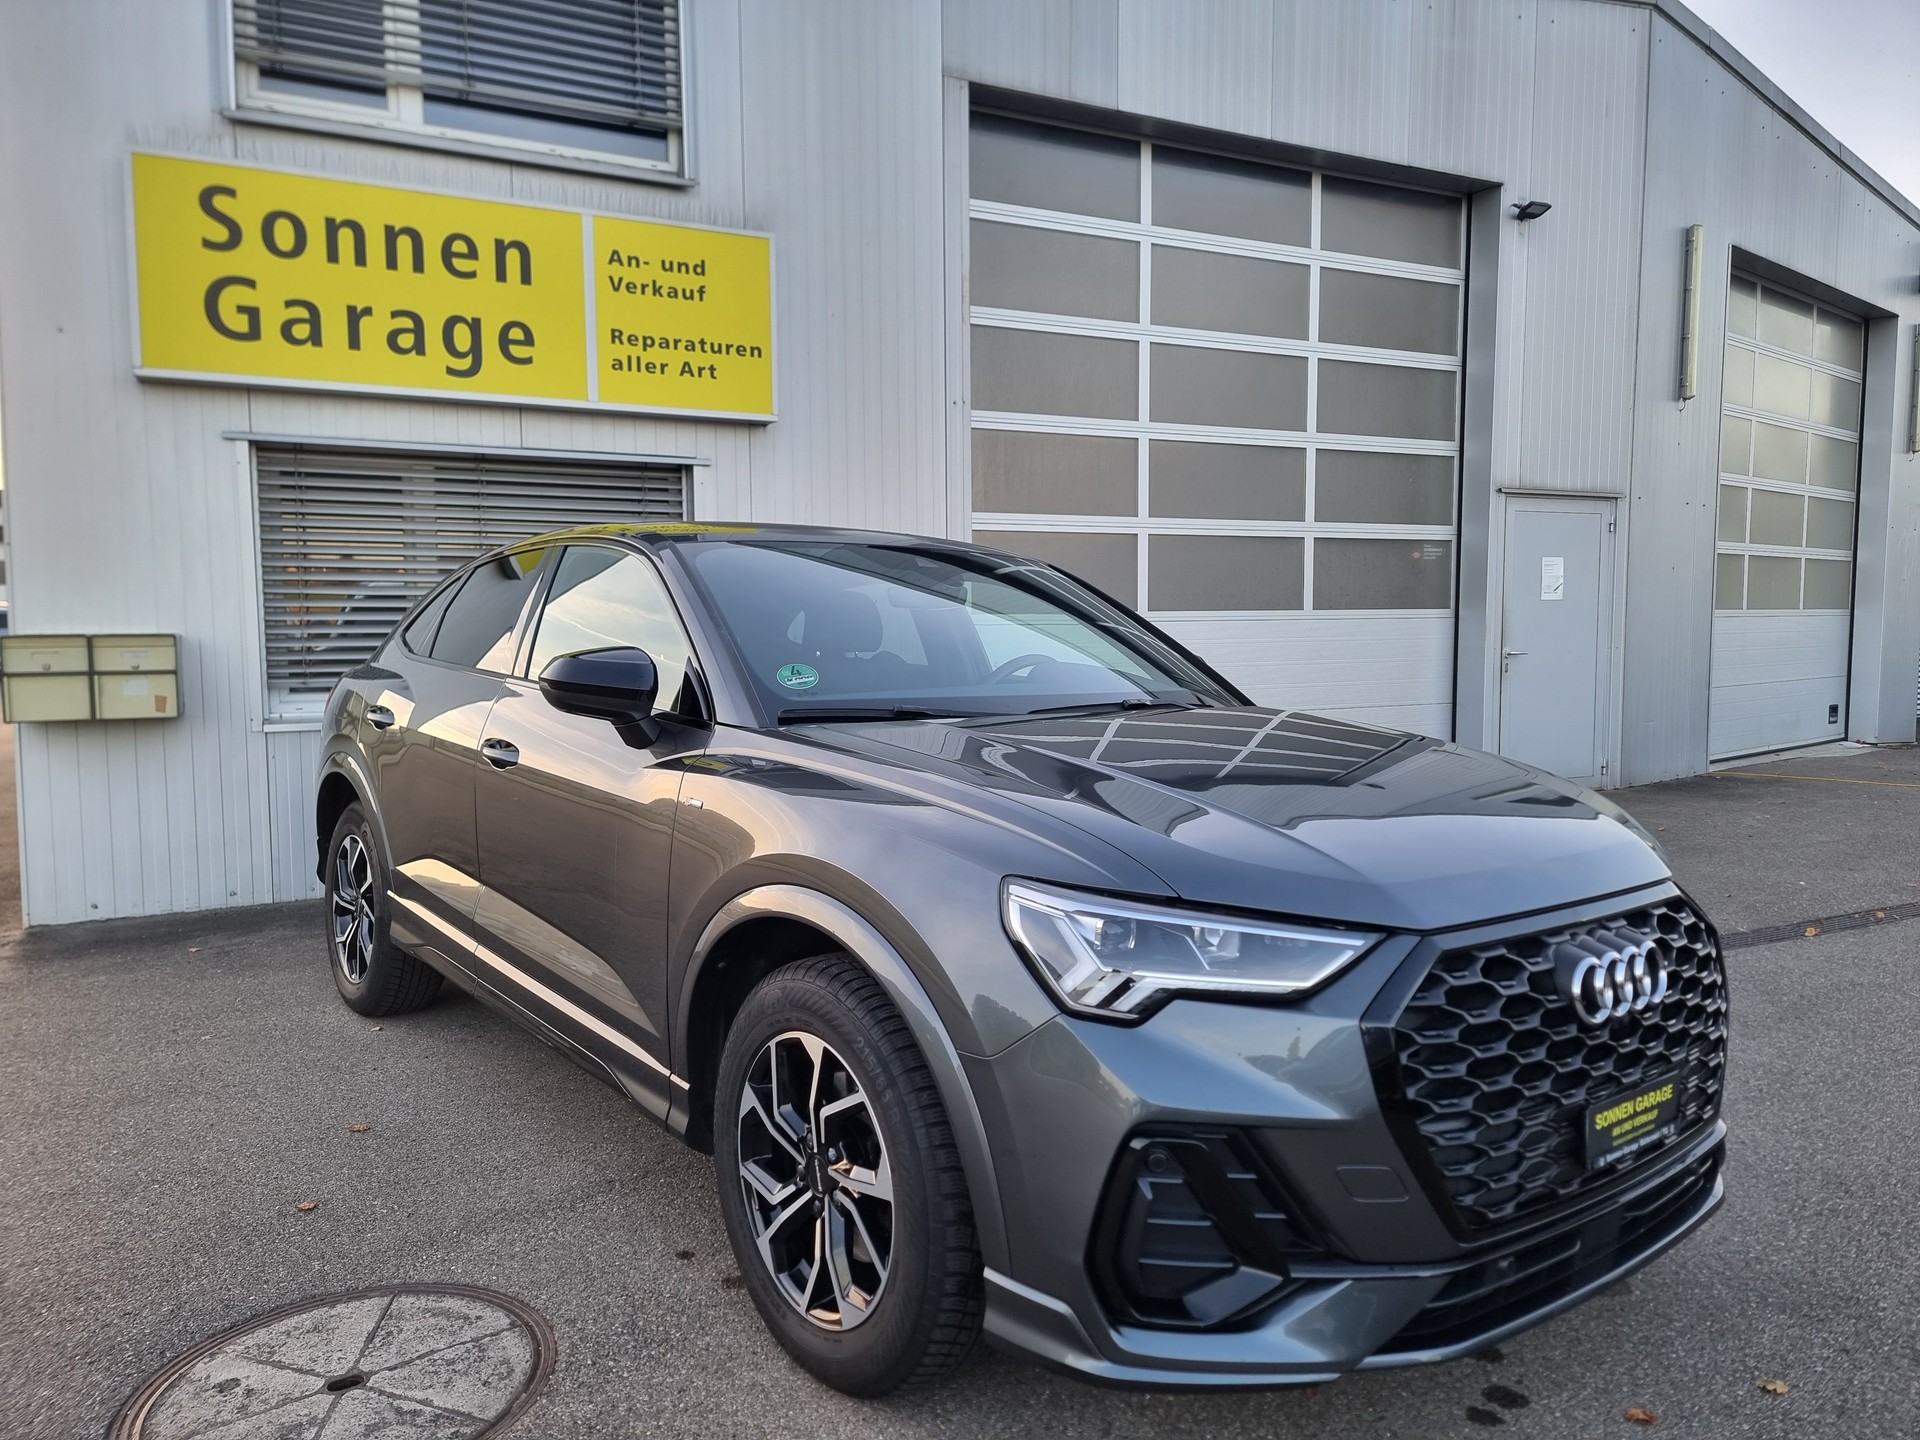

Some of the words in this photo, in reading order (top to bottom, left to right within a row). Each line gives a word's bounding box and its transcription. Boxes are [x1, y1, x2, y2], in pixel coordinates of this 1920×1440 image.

[198, 184, 533, 286] Sonnen
[608, 249, 650, 270] An-
[660, 259, 706, 277] und
[608, 275, 707, 303] Verkauf
[203, 275, 536, 379] Garage
[610, 328, 763, 359] Reparaturen
[611, 354, 669, 376] aller
[679, 361, 718, 380] Art
[853, 1035, 894, 1103] 215/65
[1594, 1099, 1635, 1131] SONNEN
[1635, 1083, 1674, 1112] GARAGE
